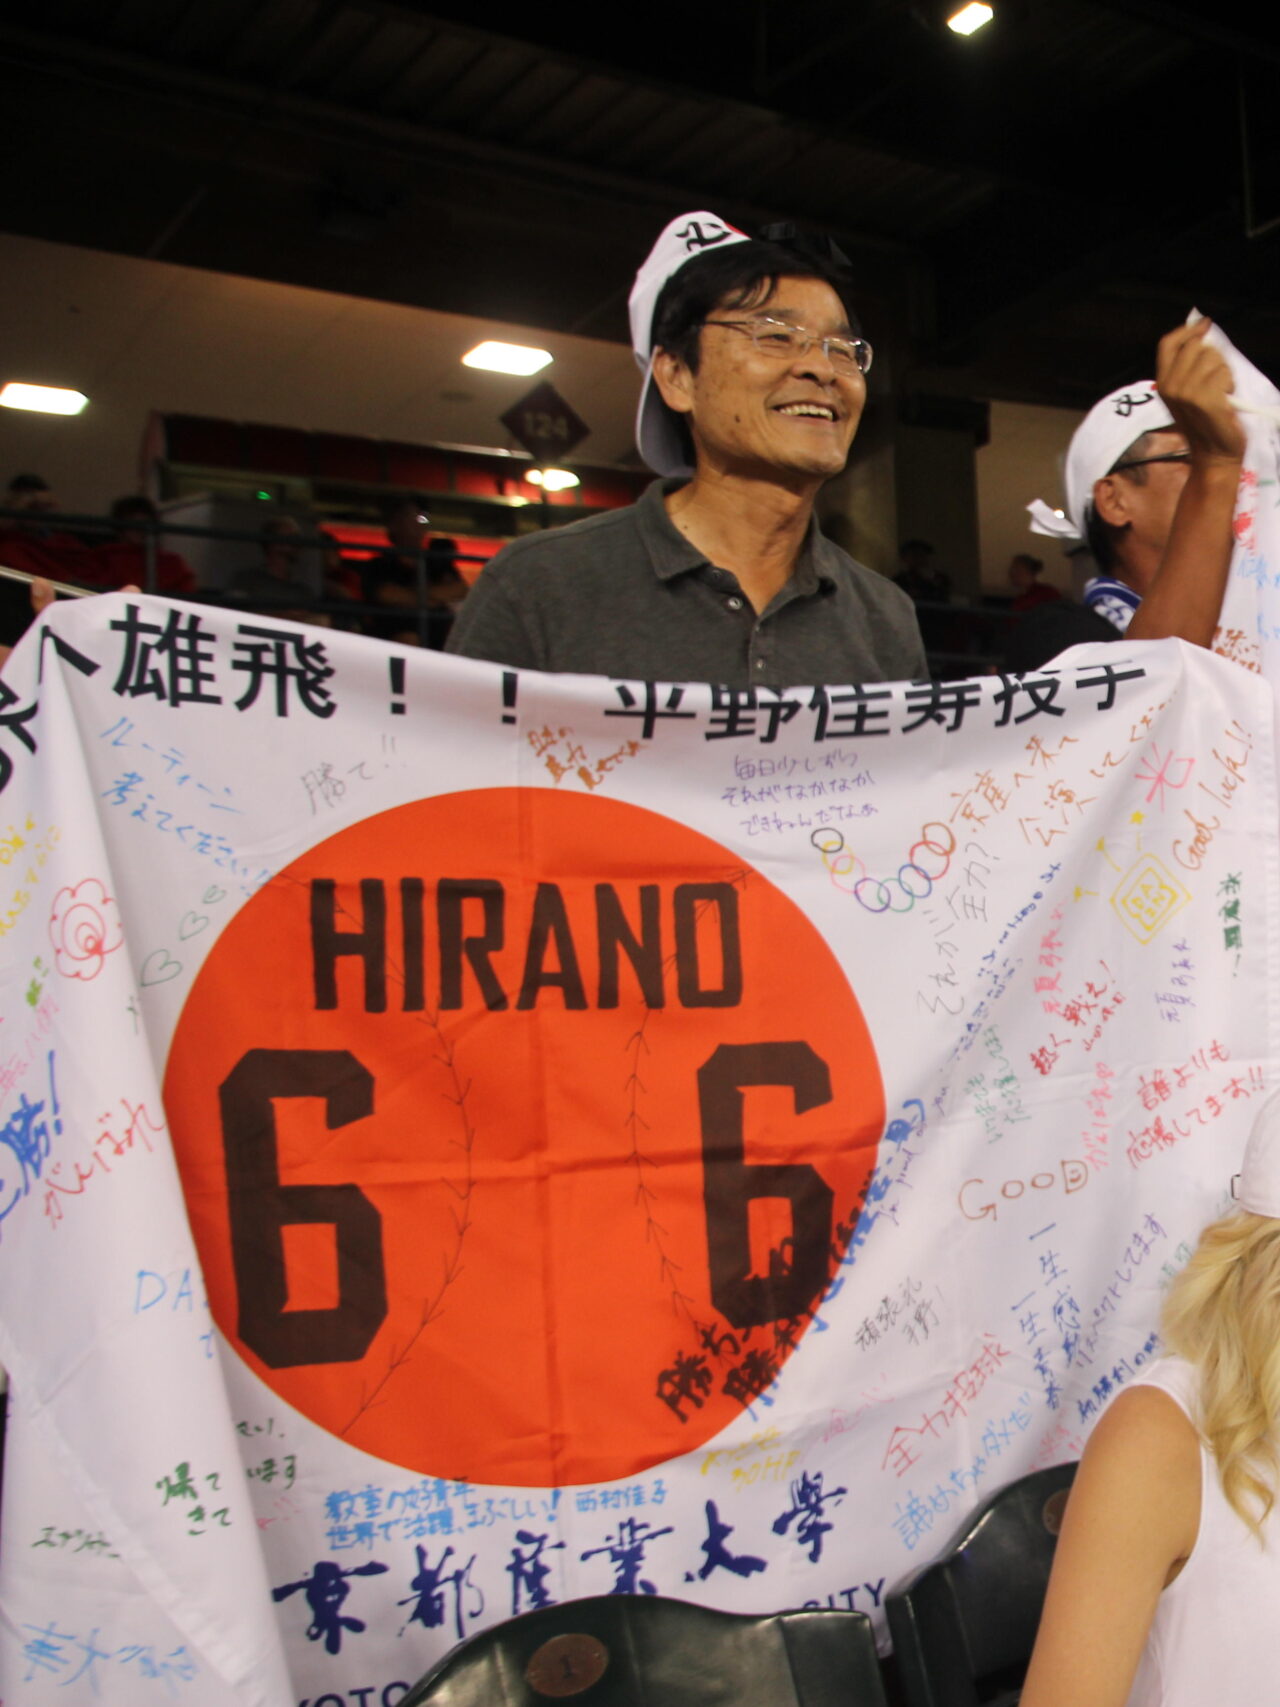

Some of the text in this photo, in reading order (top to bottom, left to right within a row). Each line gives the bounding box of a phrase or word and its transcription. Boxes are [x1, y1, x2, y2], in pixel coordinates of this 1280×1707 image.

[310, 878, 743, 1015] HIRANO
[1138, 1039, 1231, 1111] 誰よりも
[218, 1048, 388, 1366] 6
[697, 1040, 834, 1330] 6
[881, 1332, 1012, 1478] 全力投球
[574, 1479, 668, 1514] 西村佳子
